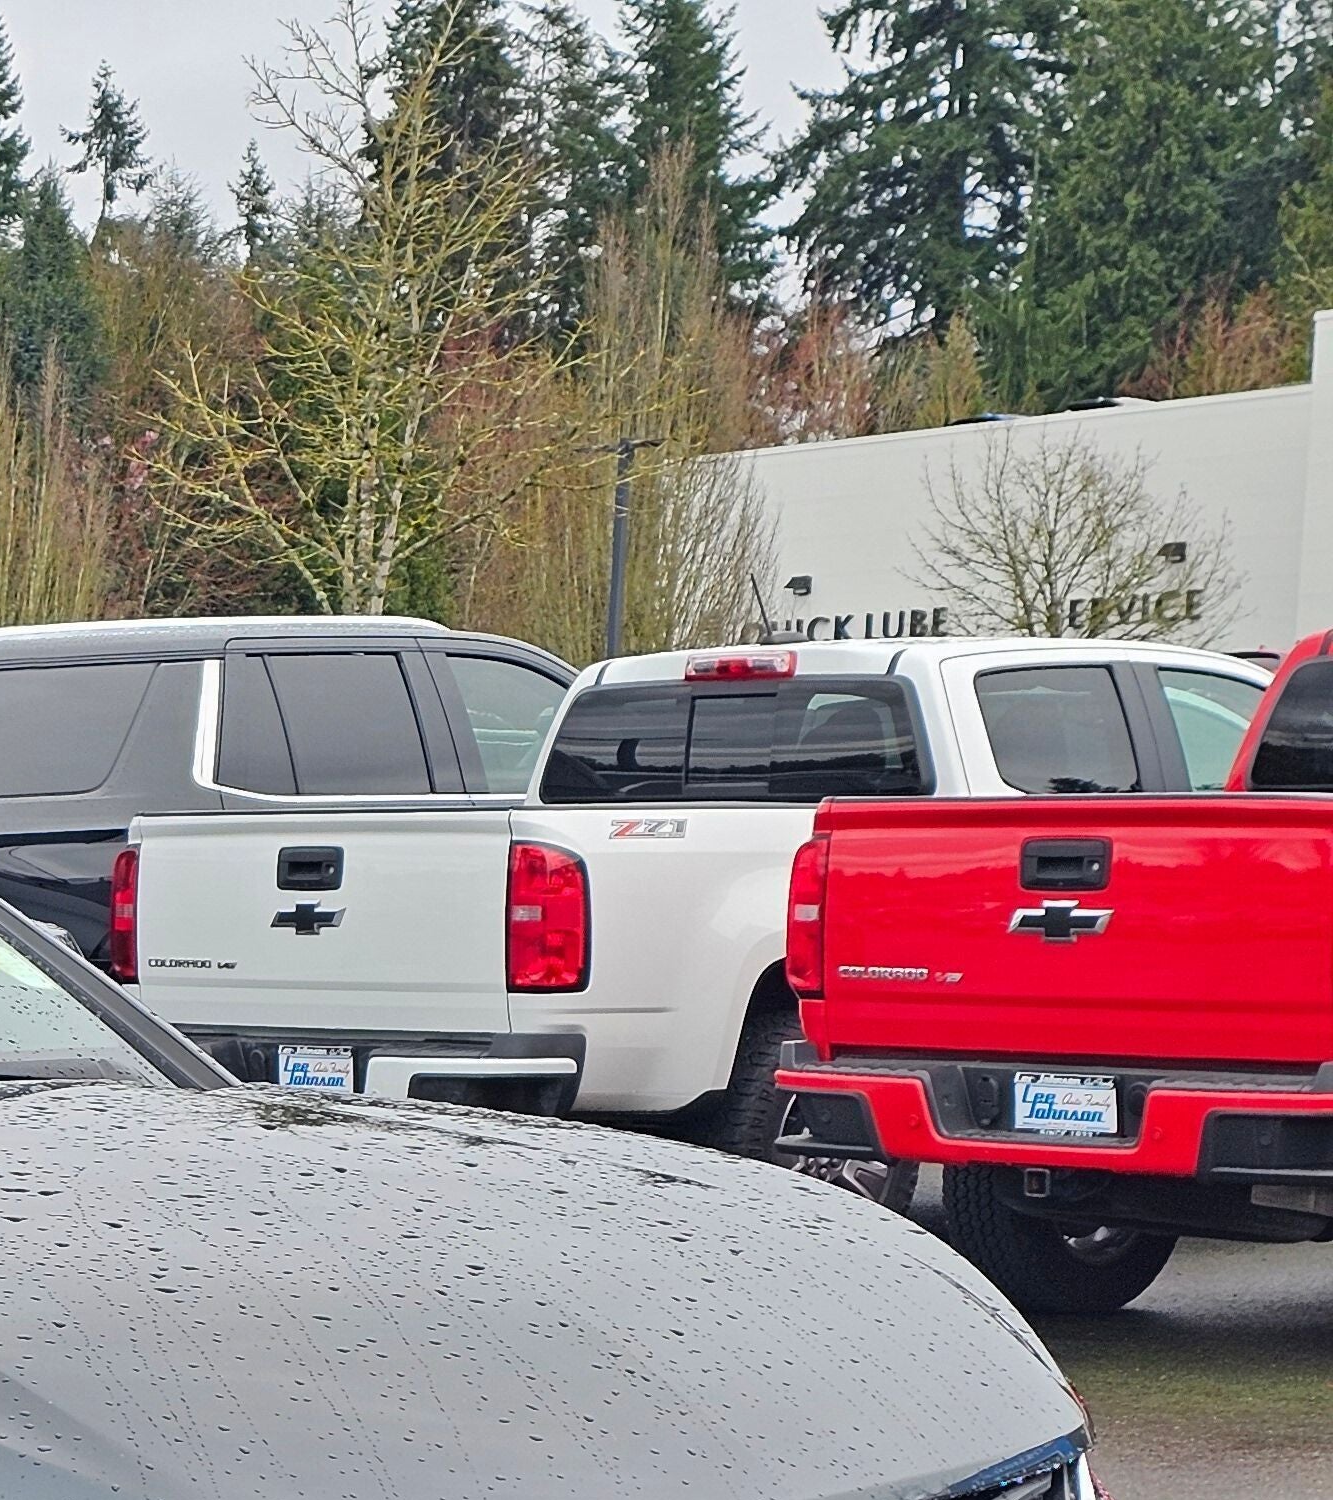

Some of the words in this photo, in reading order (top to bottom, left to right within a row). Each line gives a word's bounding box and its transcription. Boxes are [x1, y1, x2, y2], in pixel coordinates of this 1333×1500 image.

[864, 606, 949, 641] LUBE
[609, 819, 688, 839] Z71
[148, 958, 212, 969] COLORADO
[282, 1055, 311, 1074] Lee
[285, 1068, 346, 1088] Johnson
[1021, 1084, 1059, 1106] Lee
[1023, 1102, 1106, 1123] Johnson
